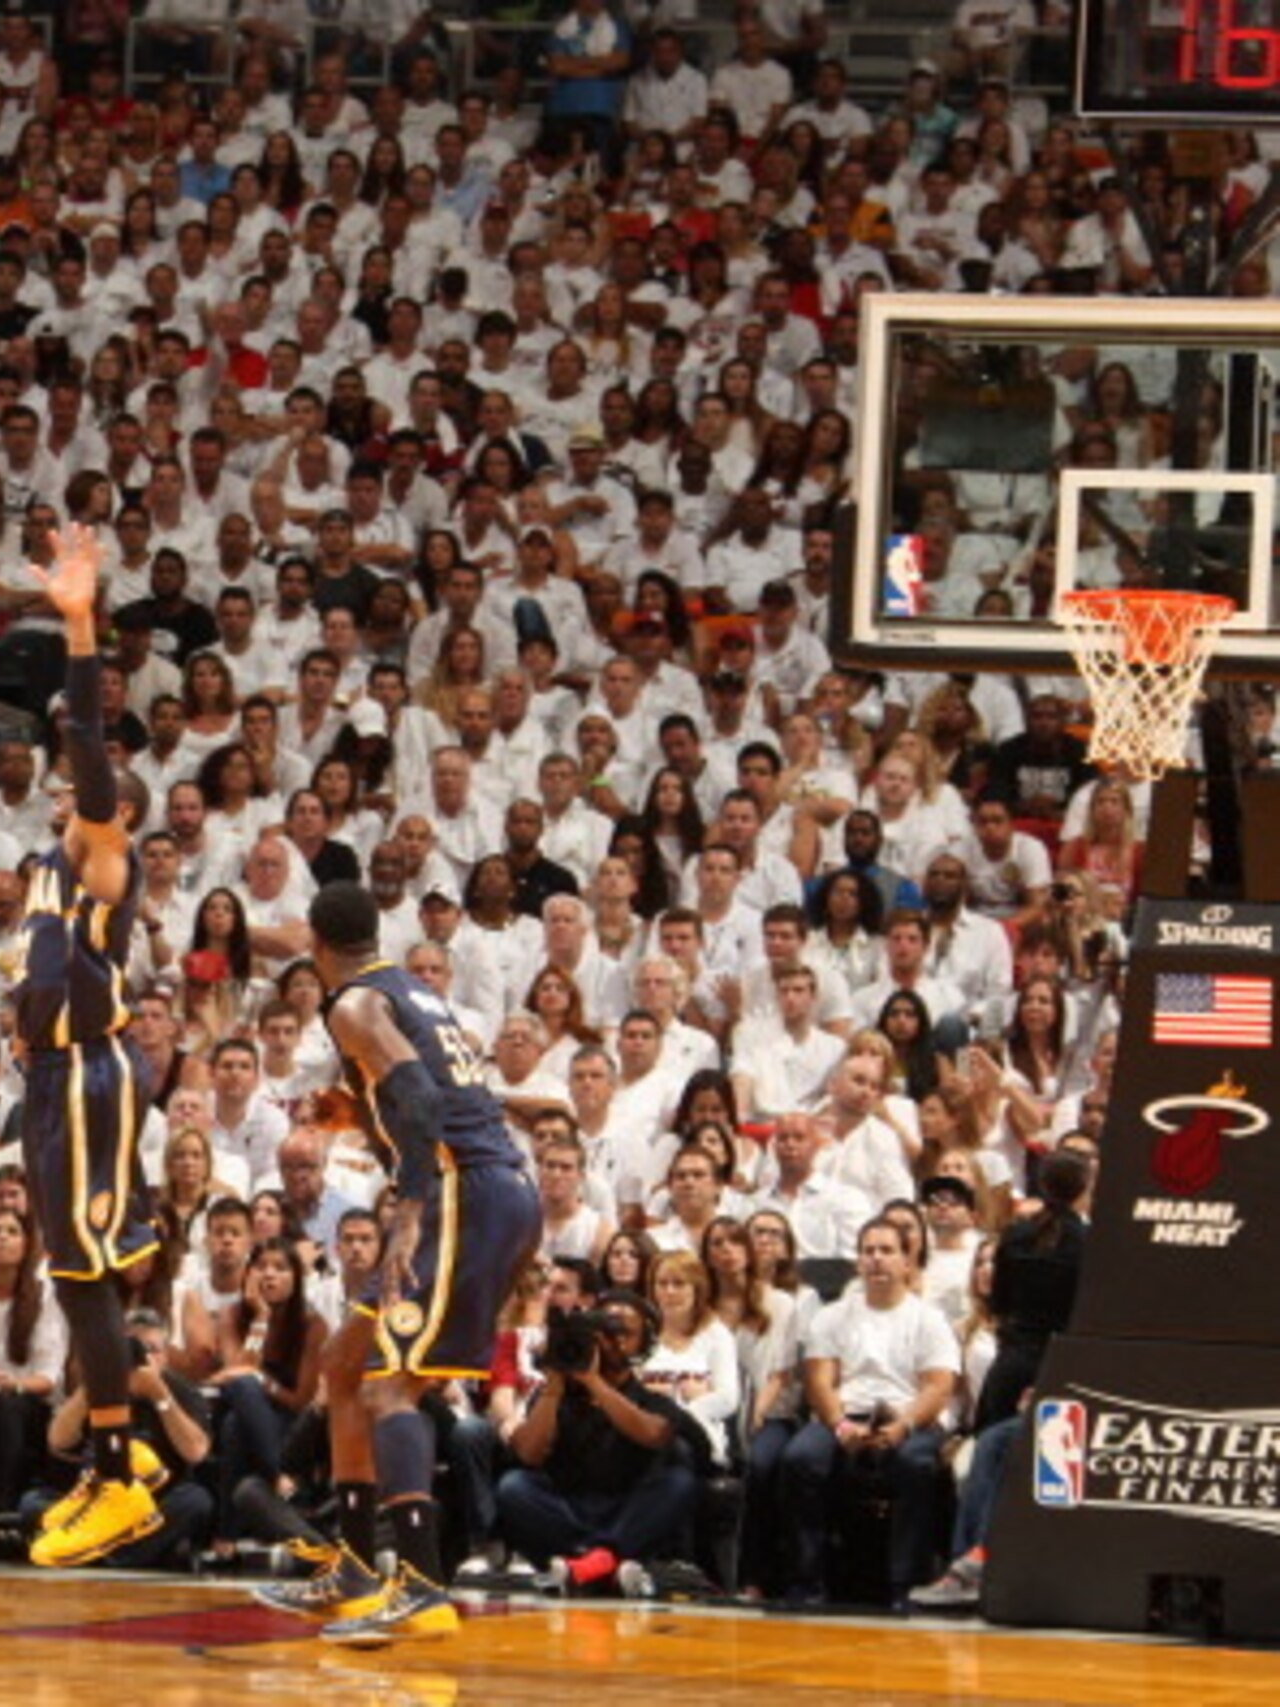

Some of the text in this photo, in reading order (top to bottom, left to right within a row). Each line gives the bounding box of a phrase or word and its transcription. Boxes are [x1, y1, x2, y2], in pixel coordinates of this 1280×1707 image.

[1157, 920, 1273, 951] SPALDING
[1132, 1197, 1236, 1225] MIAMI
[1150, 1218, 1246, 1247] HEAT
[1119, 1476, 1279, 1507] FINALS
